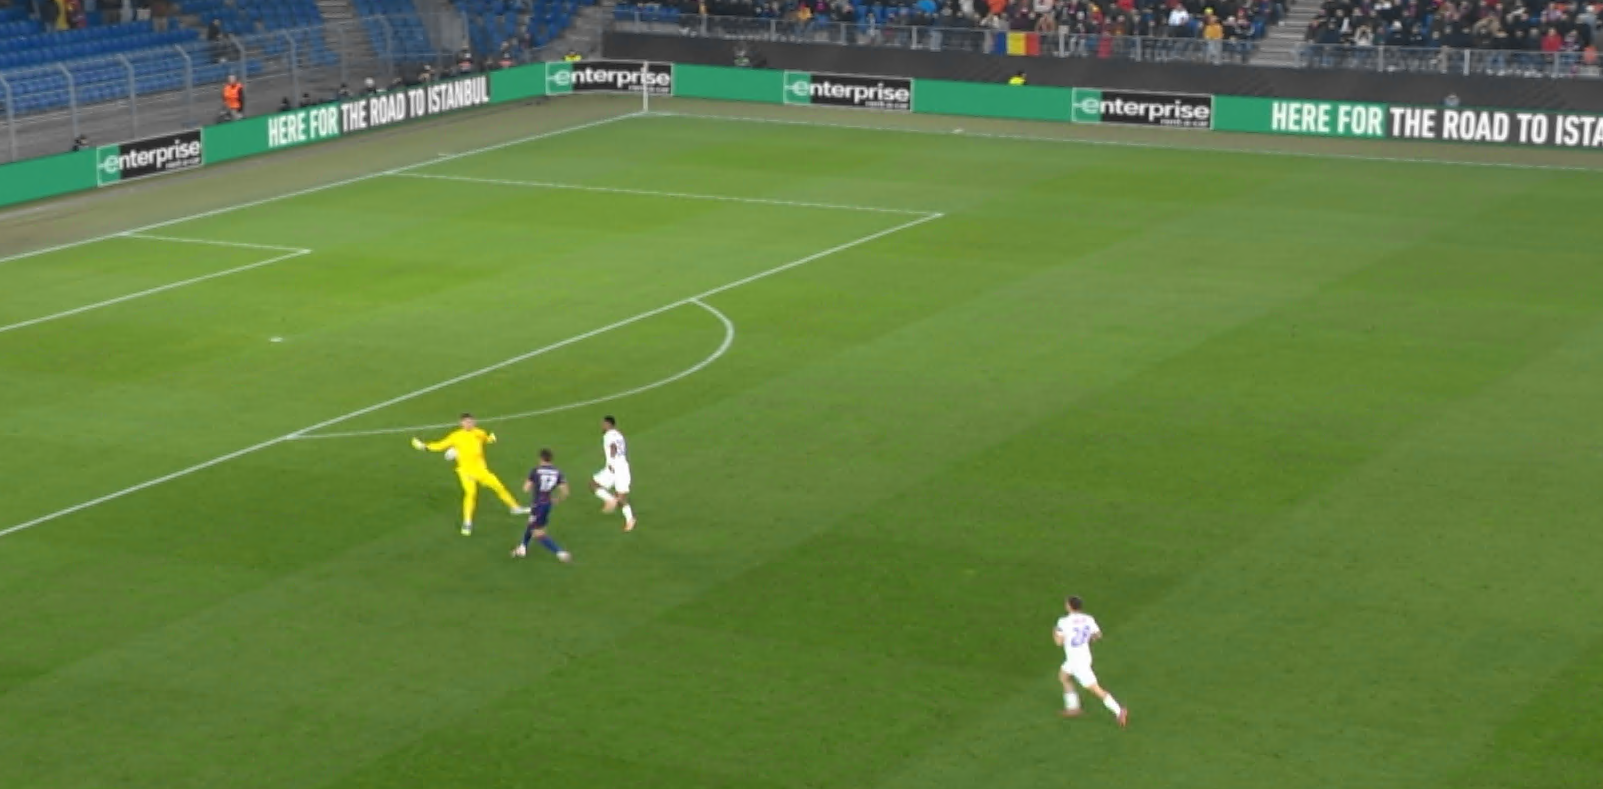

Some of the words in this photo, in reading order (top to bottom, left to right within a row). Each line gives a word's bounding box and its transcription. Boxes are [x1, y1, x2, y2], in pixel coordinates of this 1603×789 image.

[793, 80, 910, 104] enterprise
[268, 112, 306, 147] HERE
[310, 107, 338, 138] FOR
[341, 100, 367, 132] THE
[369, 92, 406, 126] ROAD
[408, 88, 424, 117] TO
[427, 75, 489, 114] ISTANBUL
[1081, 98, 1210, 122] enterprise
[1272, 102, 1331, 132] HERE
[1337, 104, 1384, 135] FOR
[1390, 106, 1437, 138] THE
[1442, 110, 1508, 142] ROAD
[1517, 113, 1549, 144] TO
[102, 139, 201, 173] enterprise
